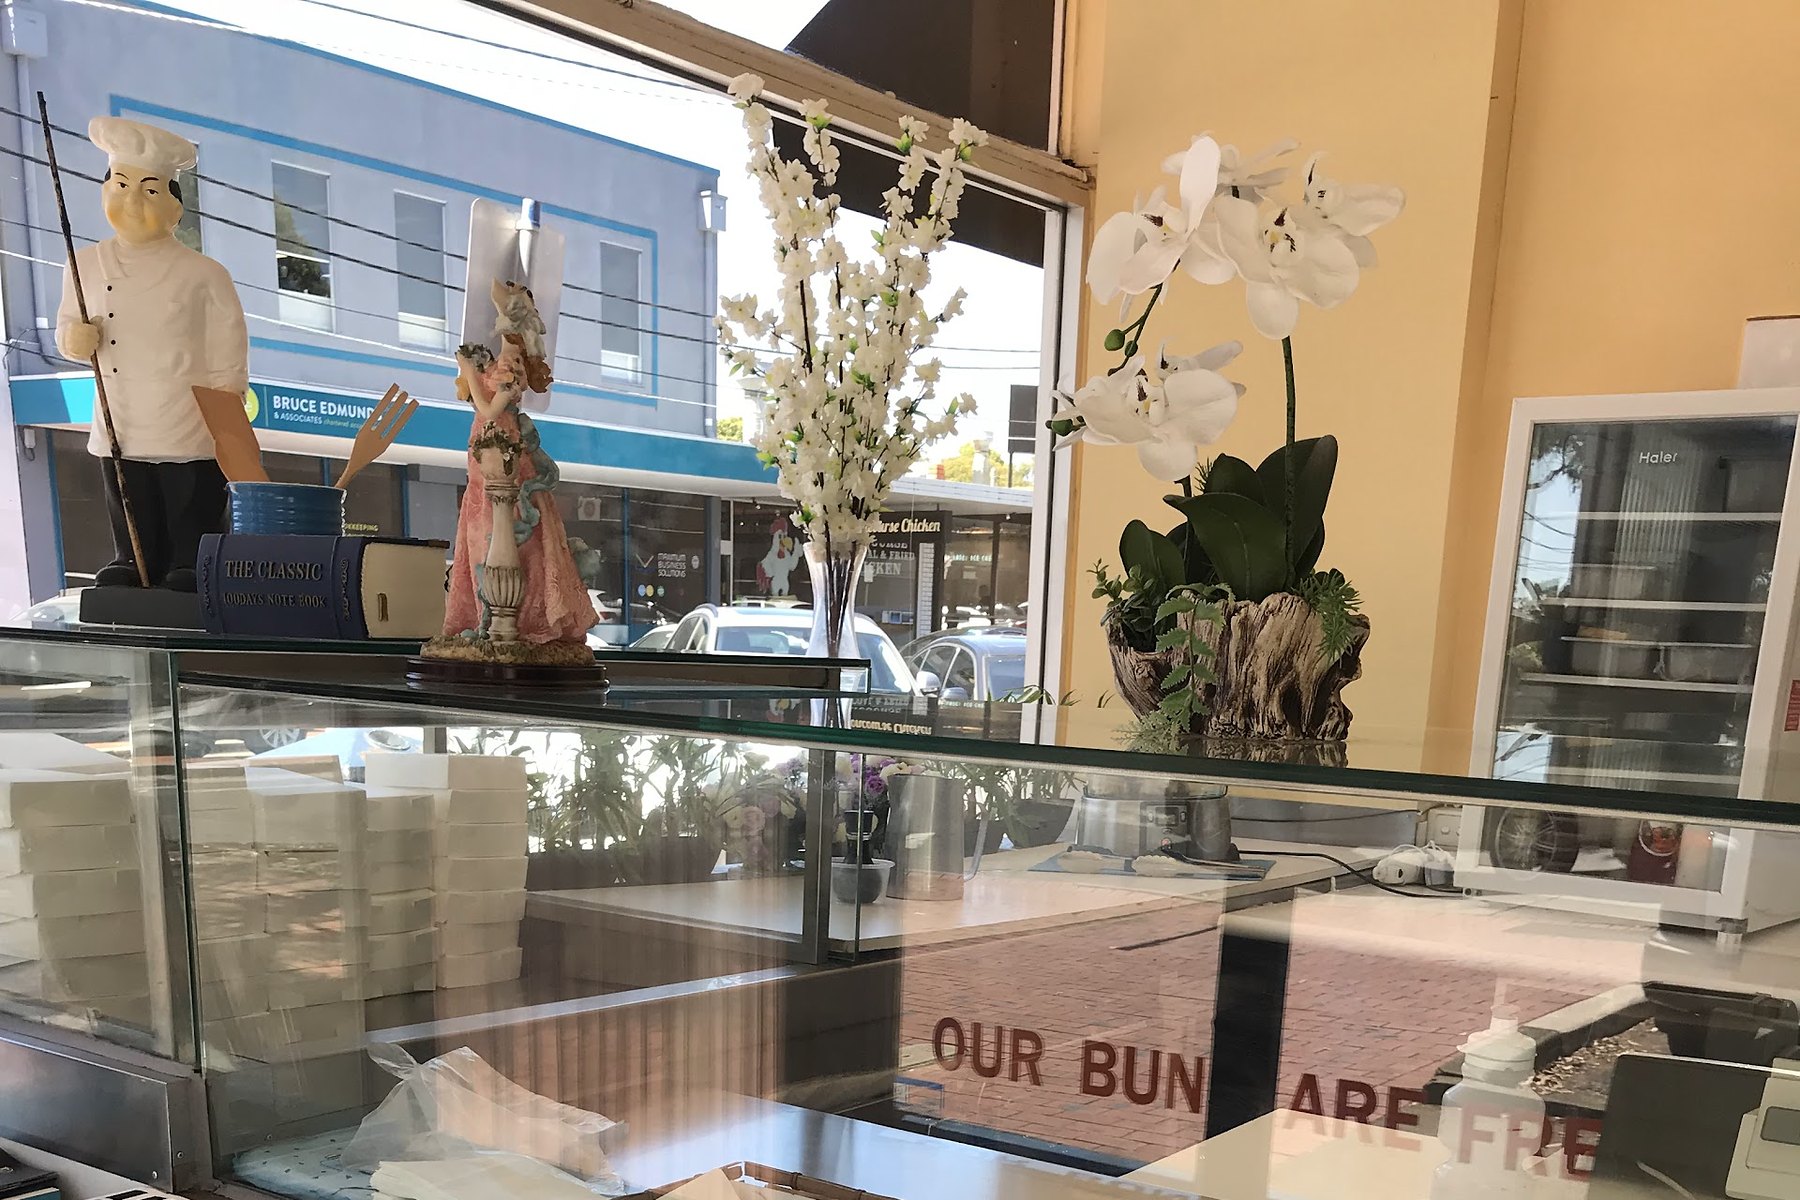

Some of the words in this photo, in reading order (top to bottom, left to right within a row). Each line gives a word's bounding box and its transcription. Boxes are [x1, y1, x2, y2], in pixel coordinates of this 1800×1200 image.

[273, 395, 316, 412] BRUCE
[320, 402, 382, 421] EDMUND
[280, 413, 322, 424] ASSOCIATES
[1638, 449, 1678, 465] Haier
[901, 518, 941, 533] Chicken
[889, 551, 915, 560] FRIED
[225, 560, 253, 578] THE
[258, 561, 322, 581] CLASSIC
[266, 594, 295, 607] NOTE
[299, 595, 326, 608] BOOK
[930, 1015, 1045, 1087] OUR
[1078, 1038, 1209, 1115] BUN
[1282, 1072, 1430, 1153] ARE
[1456, 1103, 1603, 1184] FRE
